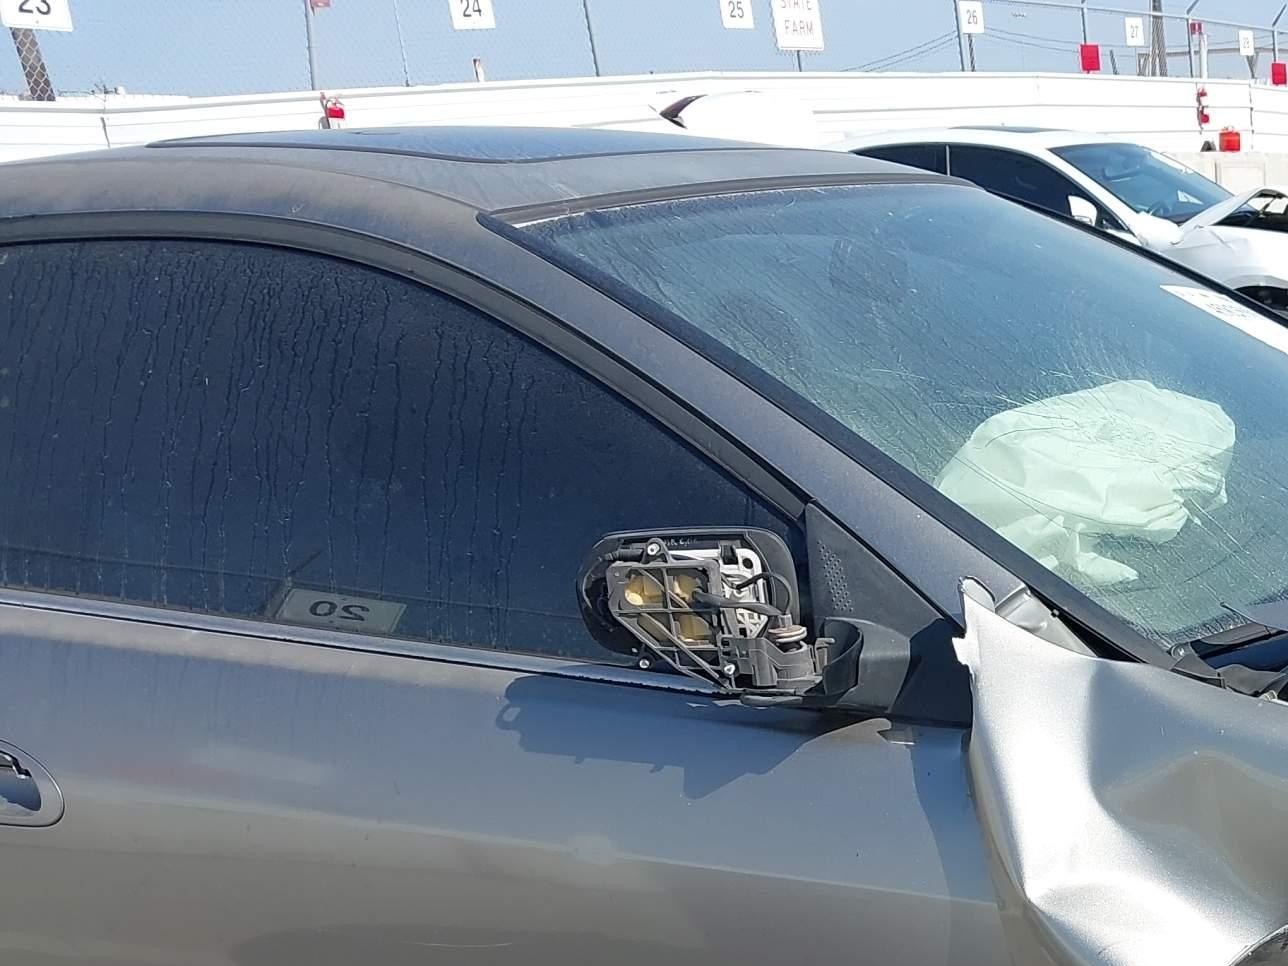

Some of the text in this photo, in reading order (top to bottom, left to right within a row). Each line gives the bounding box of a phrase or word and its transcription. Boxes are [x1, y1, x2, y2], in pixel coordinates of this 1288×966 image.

[460, 0, 482, 17] 24
[728, 0, 744, 18] 25
[966, 9, 978, 24] 26
[784, 19, 814, 37] FARM
